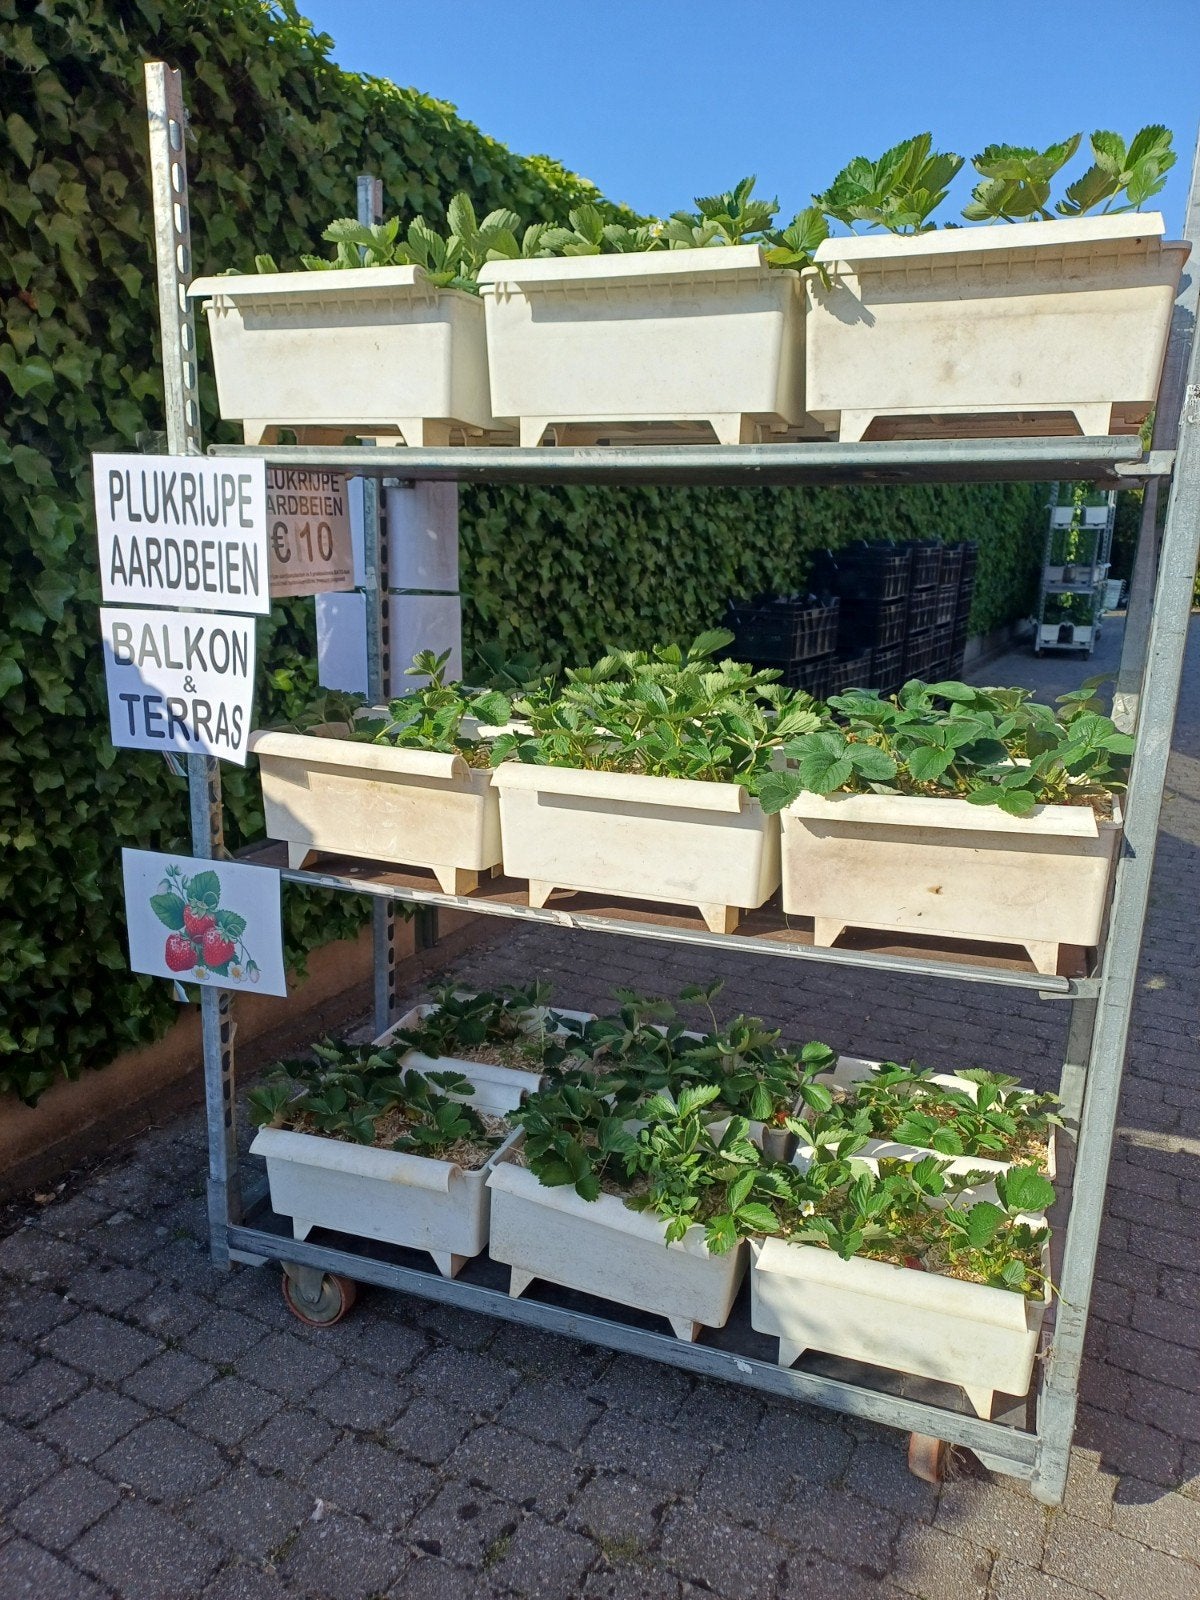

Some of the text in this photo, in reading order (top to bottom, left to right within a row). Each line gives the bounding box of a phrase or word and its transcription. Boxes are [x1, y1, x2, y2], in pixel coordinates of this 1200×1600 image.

[109, 469, 254, 529] PLUKRIJPE
[265, 494, 343, 517] ARDBEIEN
[266, 469, 340, 492] LUKRIJPE
[110, 534, 259, 597] AARDBEIEN
[111, 622, 248, 678] BALKON
[183, 675, 197, 693] &
[118, 692, 243, 750] TERRAS
